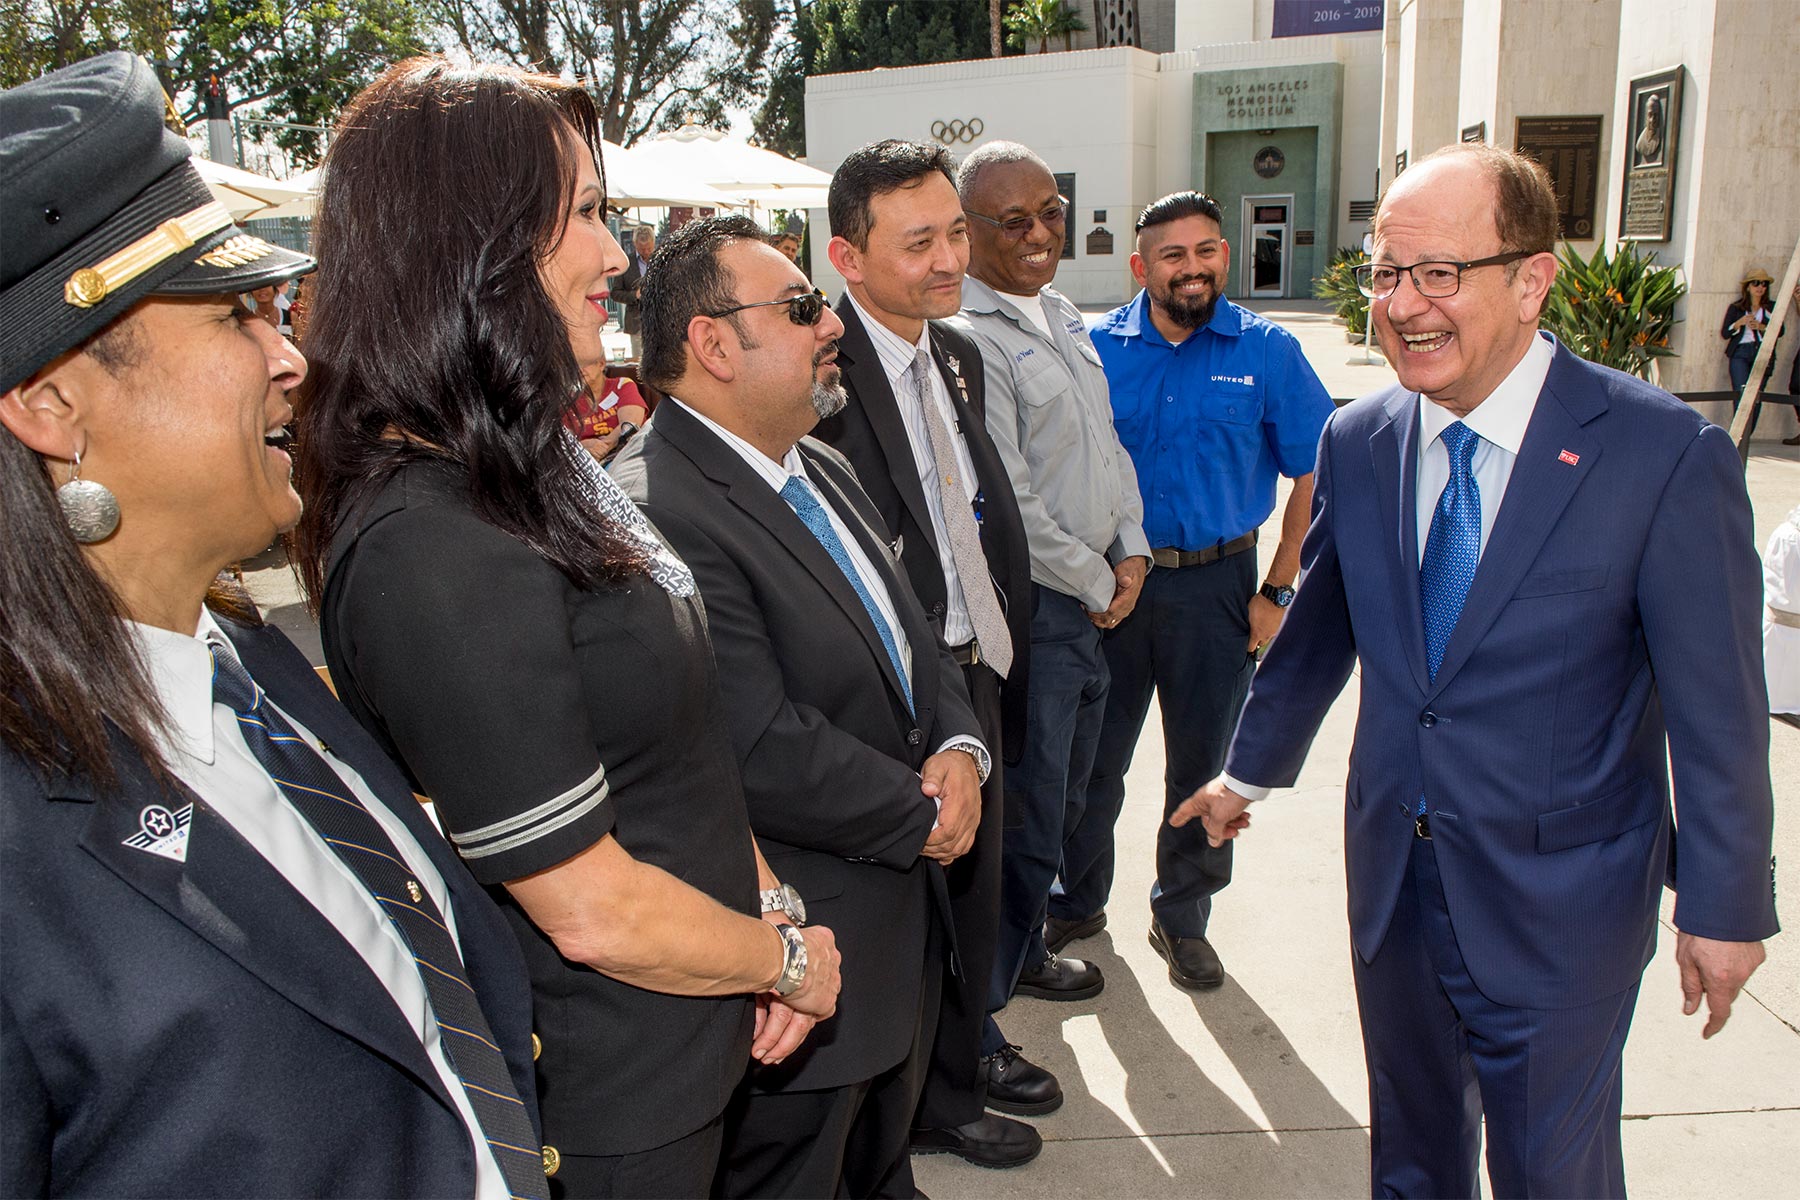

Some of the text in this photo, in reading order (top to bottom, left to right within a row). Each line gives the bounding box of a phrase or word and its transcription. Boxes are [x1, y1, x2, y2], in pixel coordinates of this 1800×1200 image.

[1314, 10, 1340, 22] 2016
[1354, 6, 1380, 19] 2019
[1217, 81, 1308, 95] LOS ANGELES
[1227, 93, 1296, 106] MEMORIAL
[1228, 106, 1294, 118] COLISEUM
[1211, 375, 1243, 383] UNITED
